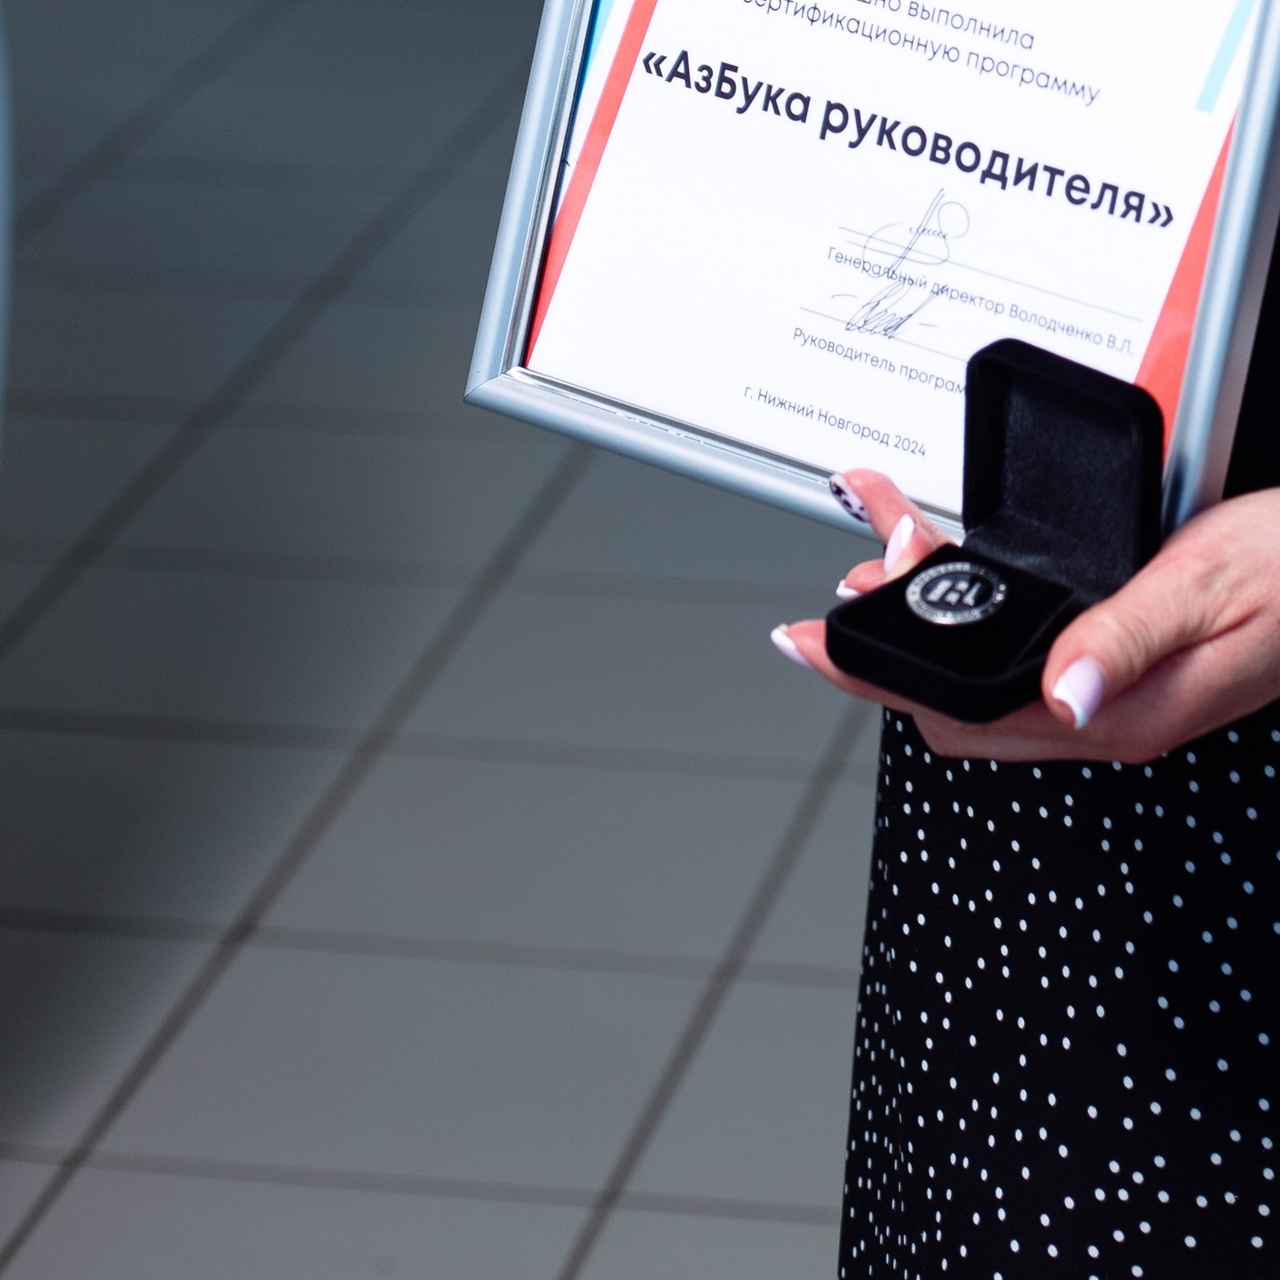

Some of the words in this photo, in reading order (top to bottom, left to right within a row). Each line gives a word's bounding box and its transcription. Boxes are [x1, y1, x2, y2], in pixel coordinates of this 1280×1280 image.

[966, 48, 1101, 107] программу
[641, 48, 811, 124] «АзБука
[819, 99, 1175, 230] руководителя»
[827, 246, 928, 292] Генеральный
[930, 281, 1005, 319] директор
[1009, 304, 1103, 347] Володченко
[793, 327, 896, 374] Руководитель
[899, 363, 967, 396] програм
[743, 385, 754, 399] г.
[757, 388, 815, 420] Нижний
[817, 408, 890, 447] Новгород
[894, 434, 927, 458] 2024
